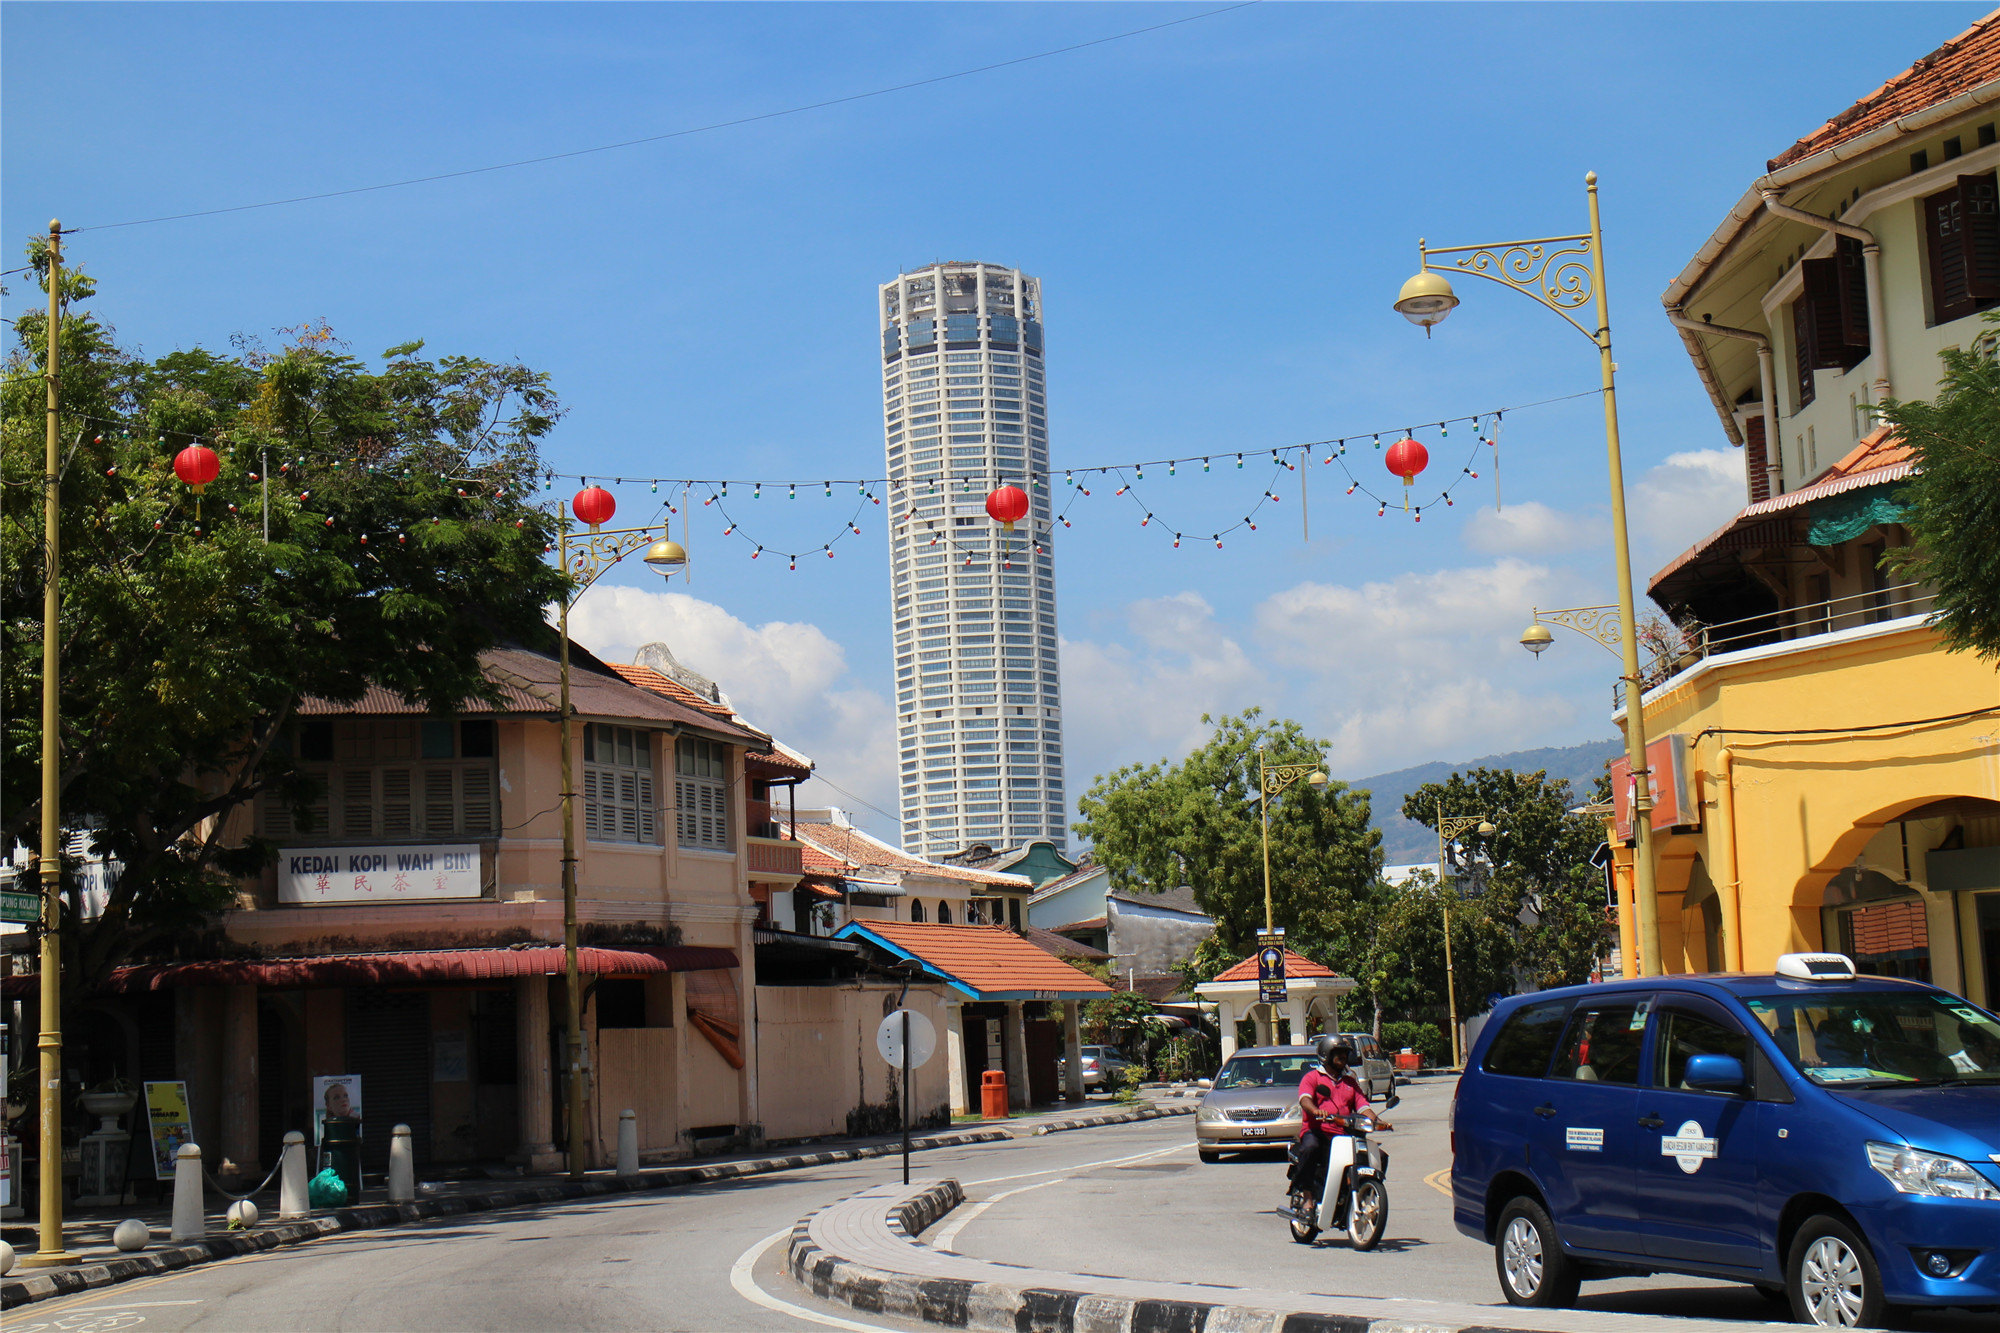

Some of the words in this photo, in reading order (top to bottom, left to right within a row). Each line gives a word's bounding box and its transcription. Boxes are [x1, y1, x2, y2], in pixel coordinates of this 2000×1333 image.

[290, 855, 339, 874] KEDAI
[349, 854, 387, 873] KOPI
[397, 853, 433, 872] WAH
[443, 852, 471, 871] BIN
[315, 872, 449, 894] 華民茶室
[0, 896, 18, 908] PUNG
[19, 898, 38, 910] KOLAM
